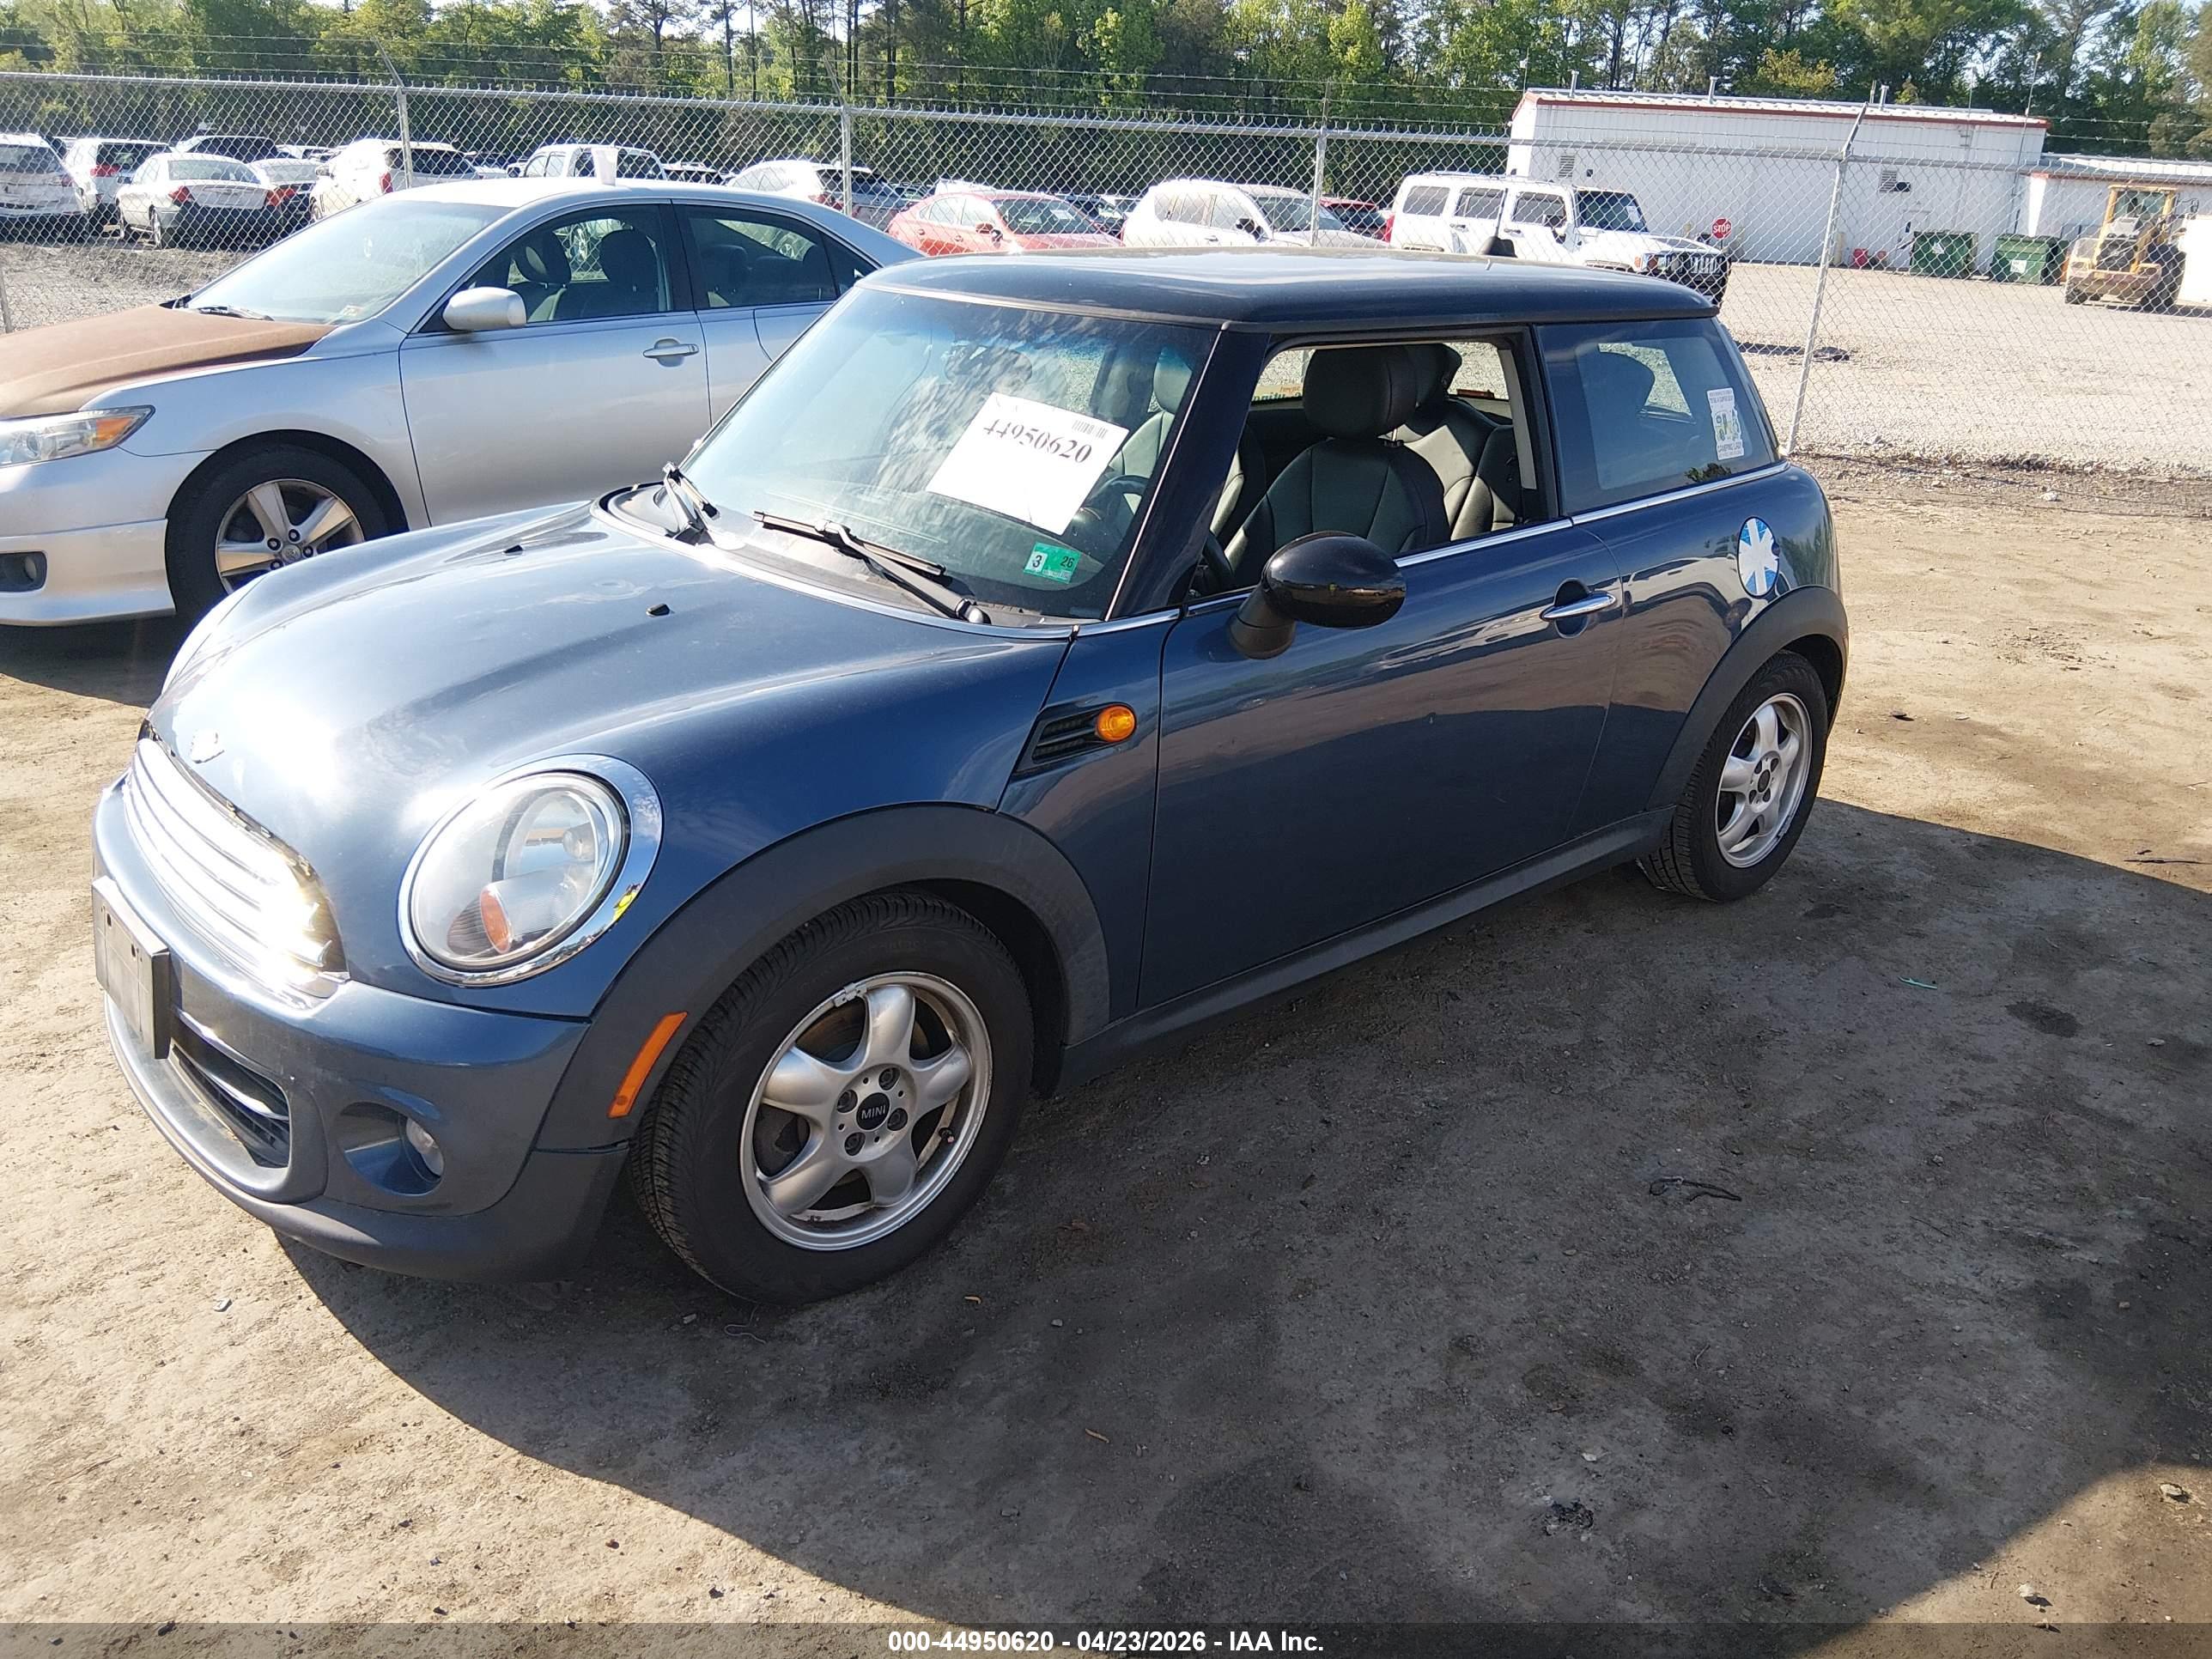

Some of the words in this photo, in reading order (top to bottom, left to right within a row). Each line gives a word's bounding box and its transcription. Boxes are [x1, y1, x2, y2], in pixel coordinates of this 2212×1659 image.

[1713, 223, 1731, 234] STOP
[983, 419, 1092, 463] 44950620
[1032, 555, 1042, 568] 3
[1060, 556, 1075, 568] 26
[860, 1104, 886, 1120] MINI
